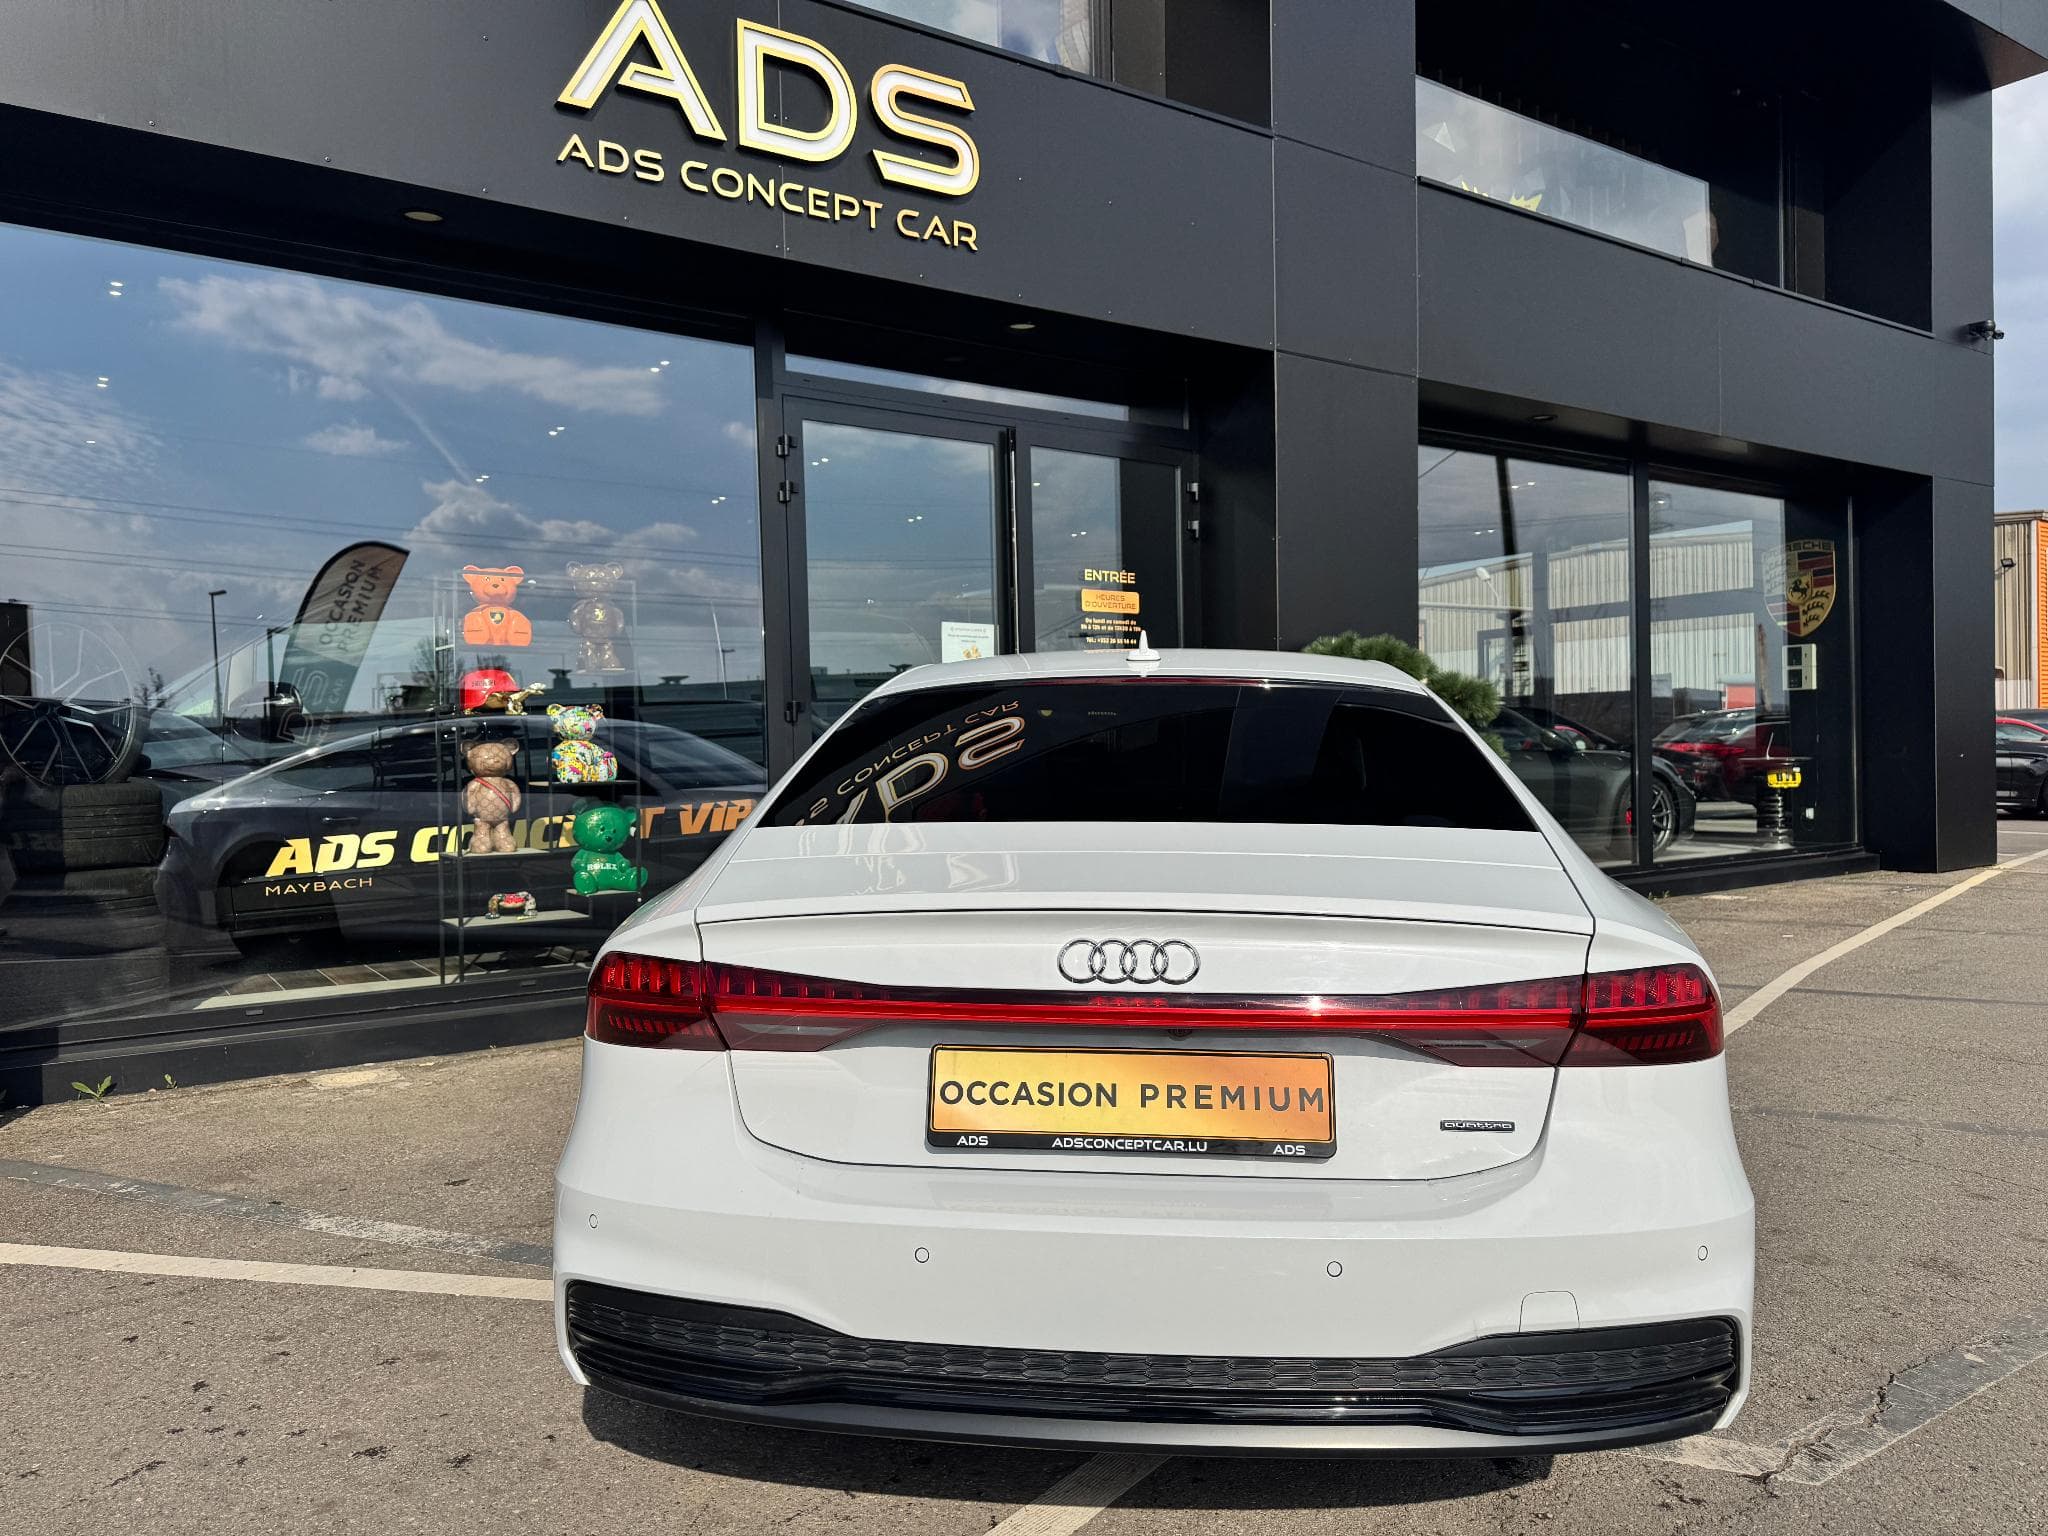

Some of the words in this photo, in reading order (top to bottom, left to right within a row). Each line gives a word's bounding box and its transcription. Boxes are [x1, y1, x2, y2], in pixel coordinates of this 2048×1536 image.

[556, 0, 981, 196] ADS
[557, 133, 665, 182] ADS
[680, 160, 884, 229] CONCEPT
[896, 208, 980, 251] CAR
[1084, 568, 1136, 584] ENTRÉE
[319, 559, 366, 646] OCCASION
[337, 566, 384, 653] PREMIUM
[1096, 593, 1126, 602] HEURES
[265, 830, 399, 878] ADS
[265, 877, 373, 897] MAYBACH
[939, 1080, 1118, 1108] OCCASION
[1140, 1084, 1325, 1113] PREMIUM
[1443, 1121, 1513, 1130] quattro
[956, 1134, 990, 1147] ADS
[1051, 1137, 1209, 1153] ADSCONCEPTCAR.LU
[1272, 1143, 1307, 1157] ADS
